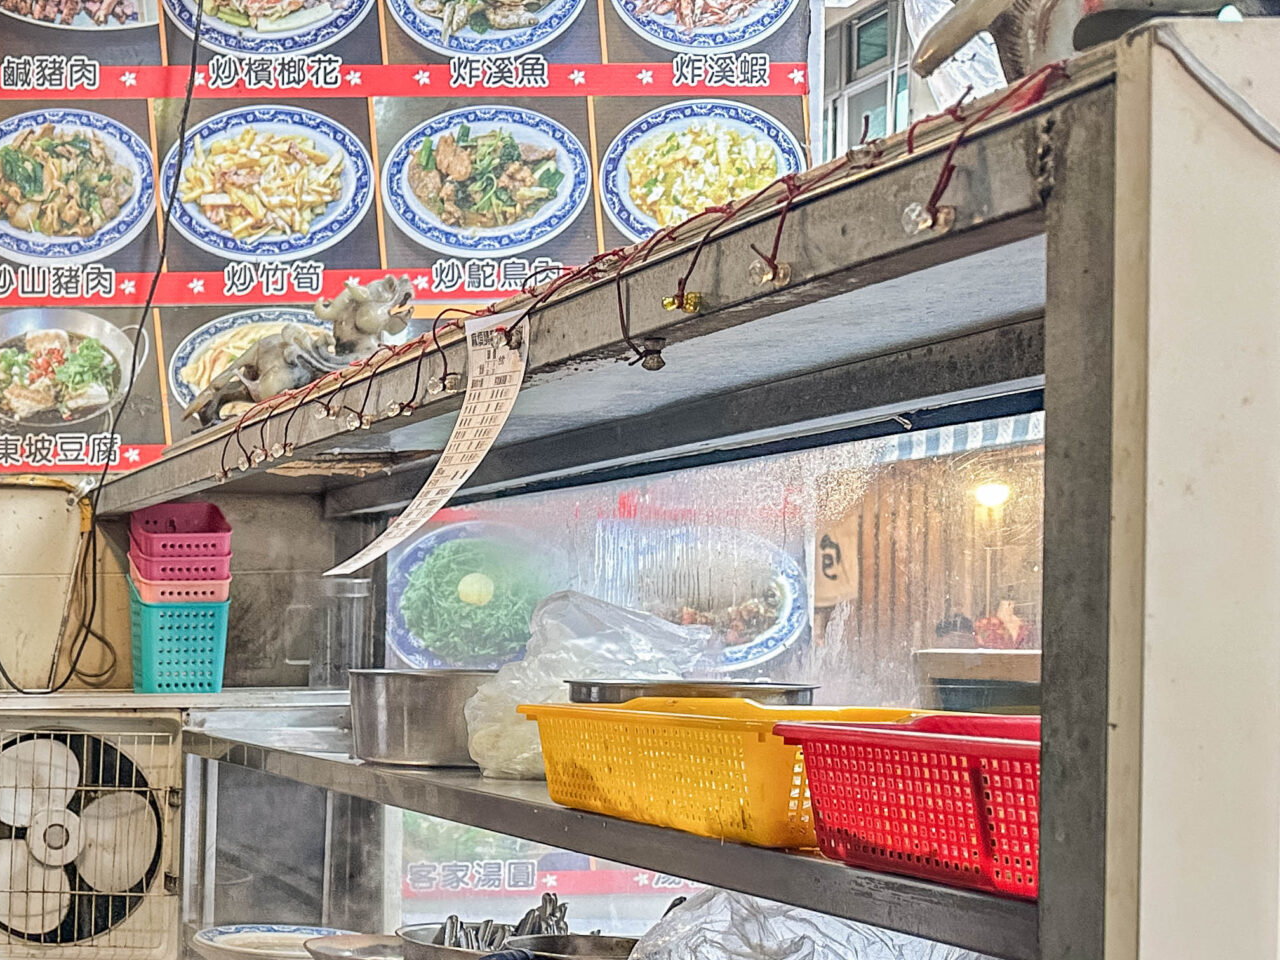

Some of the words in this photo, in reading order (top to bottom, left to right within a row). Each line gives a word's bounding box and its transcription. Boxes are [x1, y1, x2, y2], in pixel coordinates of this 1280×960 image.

[2, 57, 98, 88] 鹹豬肉
[209, 56, 341, 87] 炒檳榔花
[451, 56, 548, 87] 炸溪魚
[673, 55, 769, 86] 炸溪蝦
[224, 263, 322, 294] 炒竹筍
[433, 260, 563, 291] 炒鴕鳥肉
[407, 861, 537, 889] 客家湯圓
